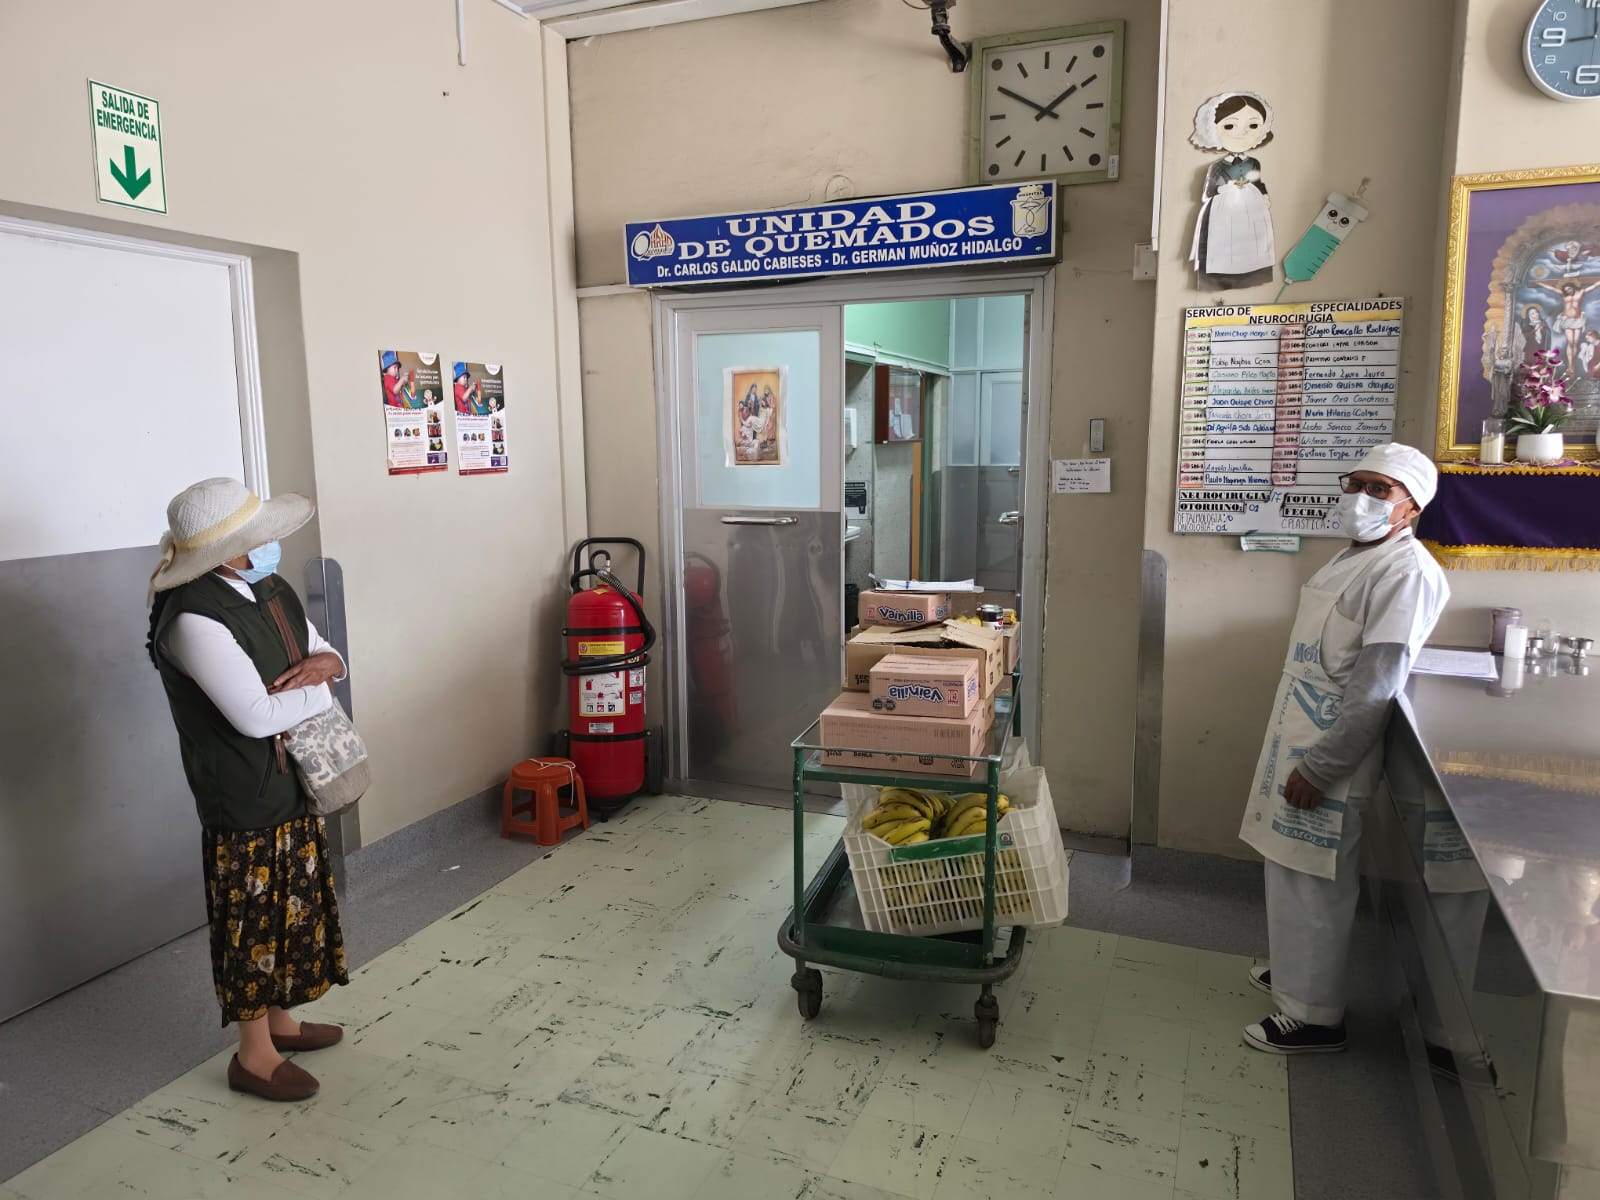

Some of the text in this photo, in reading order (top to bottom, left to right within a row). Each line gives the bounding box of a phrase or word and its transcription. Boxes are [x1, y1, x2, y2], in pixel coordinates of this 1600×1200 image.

[1553, 12, 1567, 21] 10
[1541, 27, 1566, 48] 9
[1545, 54, 1556, 64] 8
[1560, 70, 1570, 80] 7
[1575, 64, 1600, 84] 6
[101, 90, 150, 120] SALIDA DE
[96, 108, 157, 141] EMERGENCIA
[726, 201, 937, 236] UNIDAD
[678, 215, 996, 260] DE QUEMADOS
[657, 265, 672, 278] Dr.
[674, 261, 719, 277] CARLOS
[721, 258, 761, 274] GALDO
[764, 254, 822, 271] CABIESES
[832, 252, 849, 266] Dr.
[851, 247, 908, 264] GERMAN
[910, 241, 958, 260] MUÑOZ
[961, 237, 1023, 257] HIDALGO
[1187, 306, 1252, 318] SERVICIO DE
[1310, 300, 1402, 312] ESPECIALIDADES
[1249, 313, 1334, 325] NEUROCIRUGIA
[877, 606, 926, 623] Vainilla
[887, 683, 945, 703] Vainilla
[1279, 825, 1329, 847] SEMOLA
